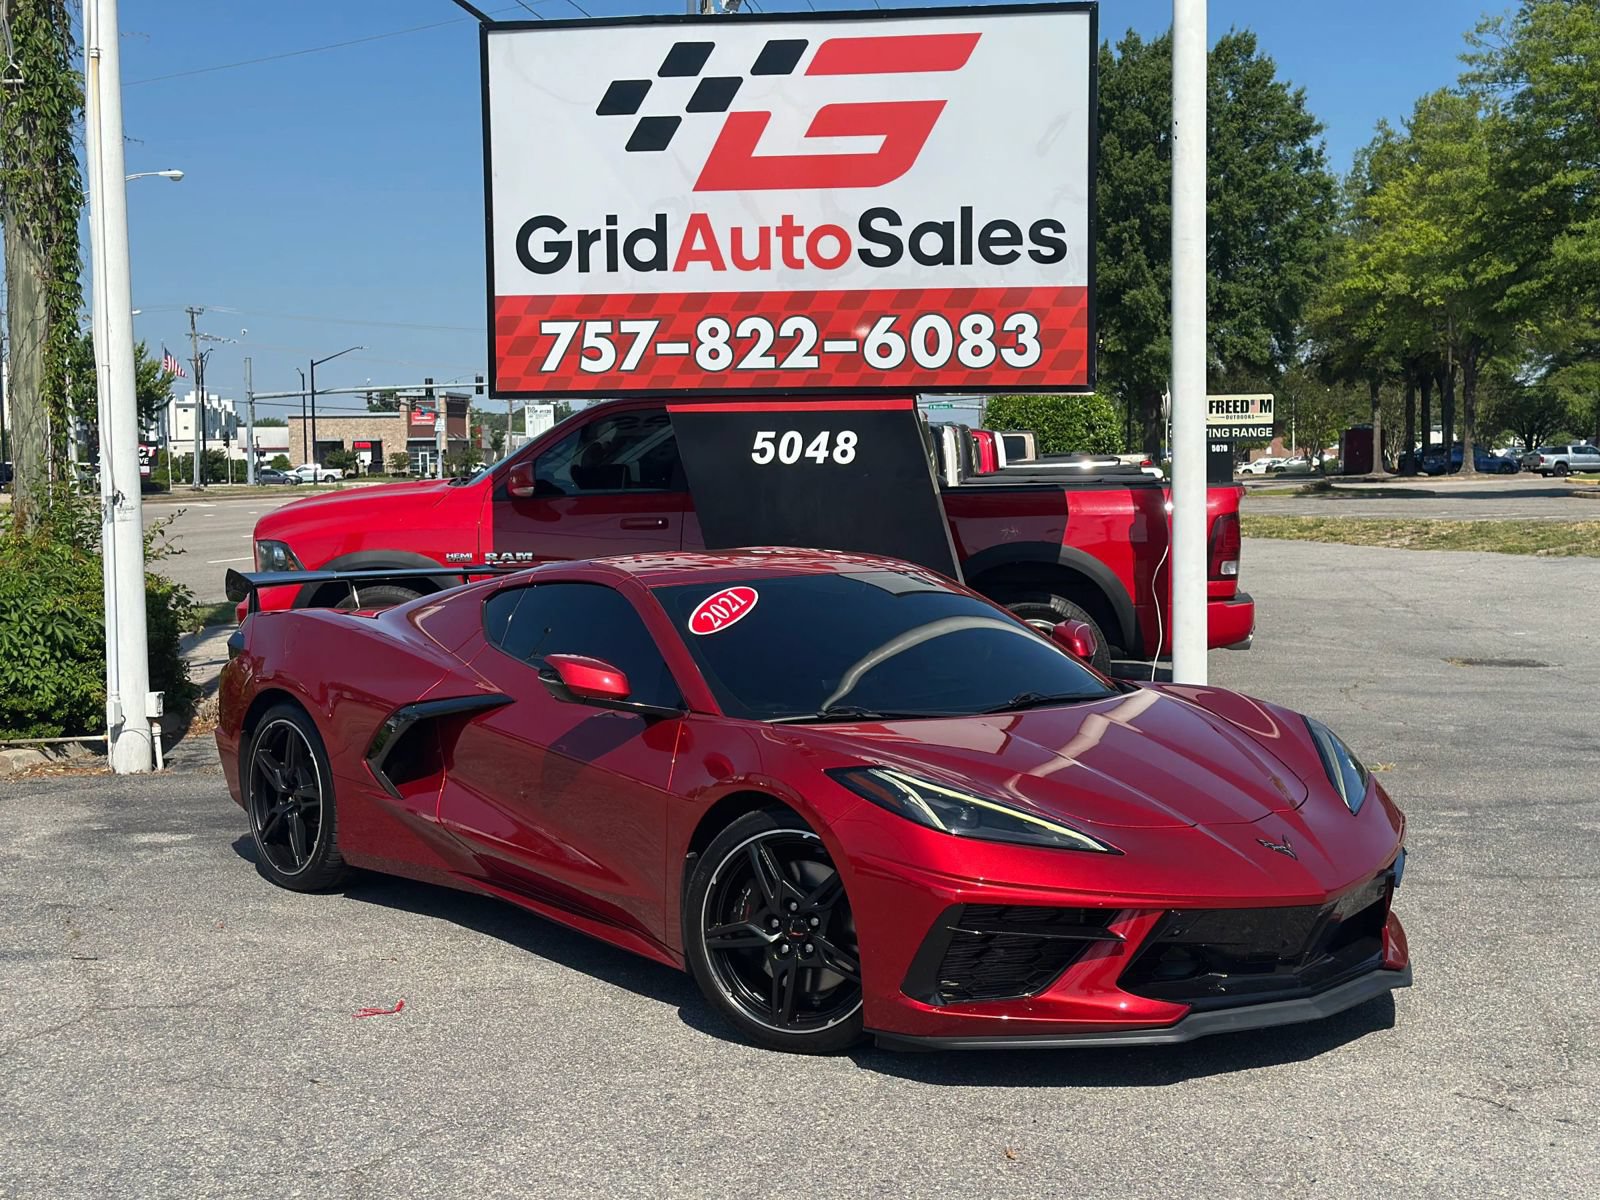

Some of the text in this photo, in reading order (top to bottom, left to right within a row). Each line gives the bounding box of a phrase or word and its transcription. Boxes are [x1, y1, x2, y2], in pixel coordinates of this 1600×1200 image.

[515, 206, 1068, 275] GridAutoSales
[539, 313, 1042, 374] 757-822-6083
[751, 430, 858, 465] 5048
[1232, 427, 1273, 438] RANGE
[445, 552, 533, 561] HEMI RAM
[700, 591, 748, 629] 2021
